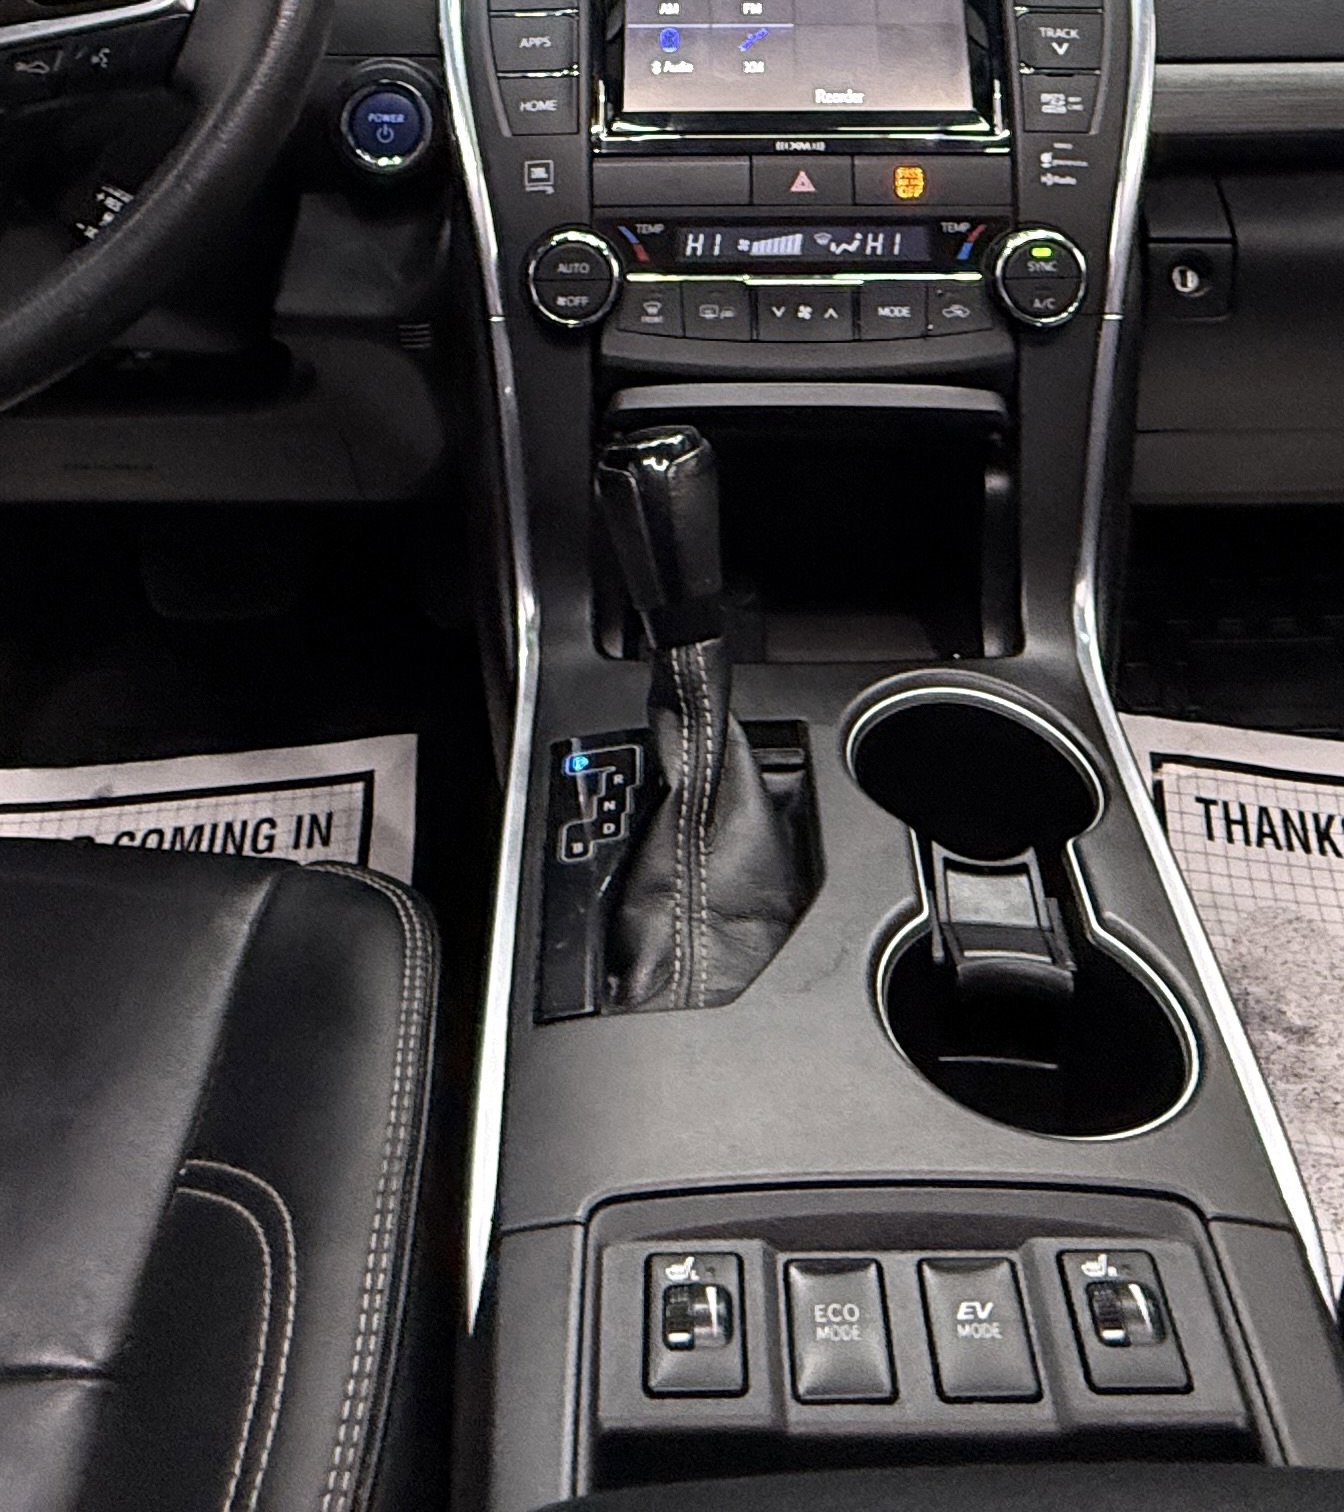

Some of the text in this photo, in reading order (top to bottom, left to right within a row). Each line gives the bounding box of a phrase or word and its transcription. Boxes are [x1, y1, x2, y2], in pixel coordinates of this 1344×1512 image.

[658, 1, 681, 16] AM
[742, 1, 763, 16] FM
[1038, 26, 1080, 39] TRACK
[519, 36, 552, 49] APPS
[520, 99, 558, 112] HOME
[367, 113, 405, 124] POWER
[634, 223, 665, 235] TEMP
[940, 221, 971, 234] TEMP
[558, 262, 590, 274] AUTO
[1027, 261, 1057, 273] SYNC
[567, 295, 590, 308] OFF
[1033, 297, 1056, 310] A/C
[878, 306, 912, 318] MODE
[613, 773, 625, 786] R
[603, 799, 617, 812] N
[293, 811, 334, 850] IN
[602, 822, 616, 835] D
[814, 1302, 861, 1323] ECO
[956, 1301, 994, 1320] EV
[816, 1324, 863, 1341] MODE
[957, 1321, 1003, 1339] MODE
